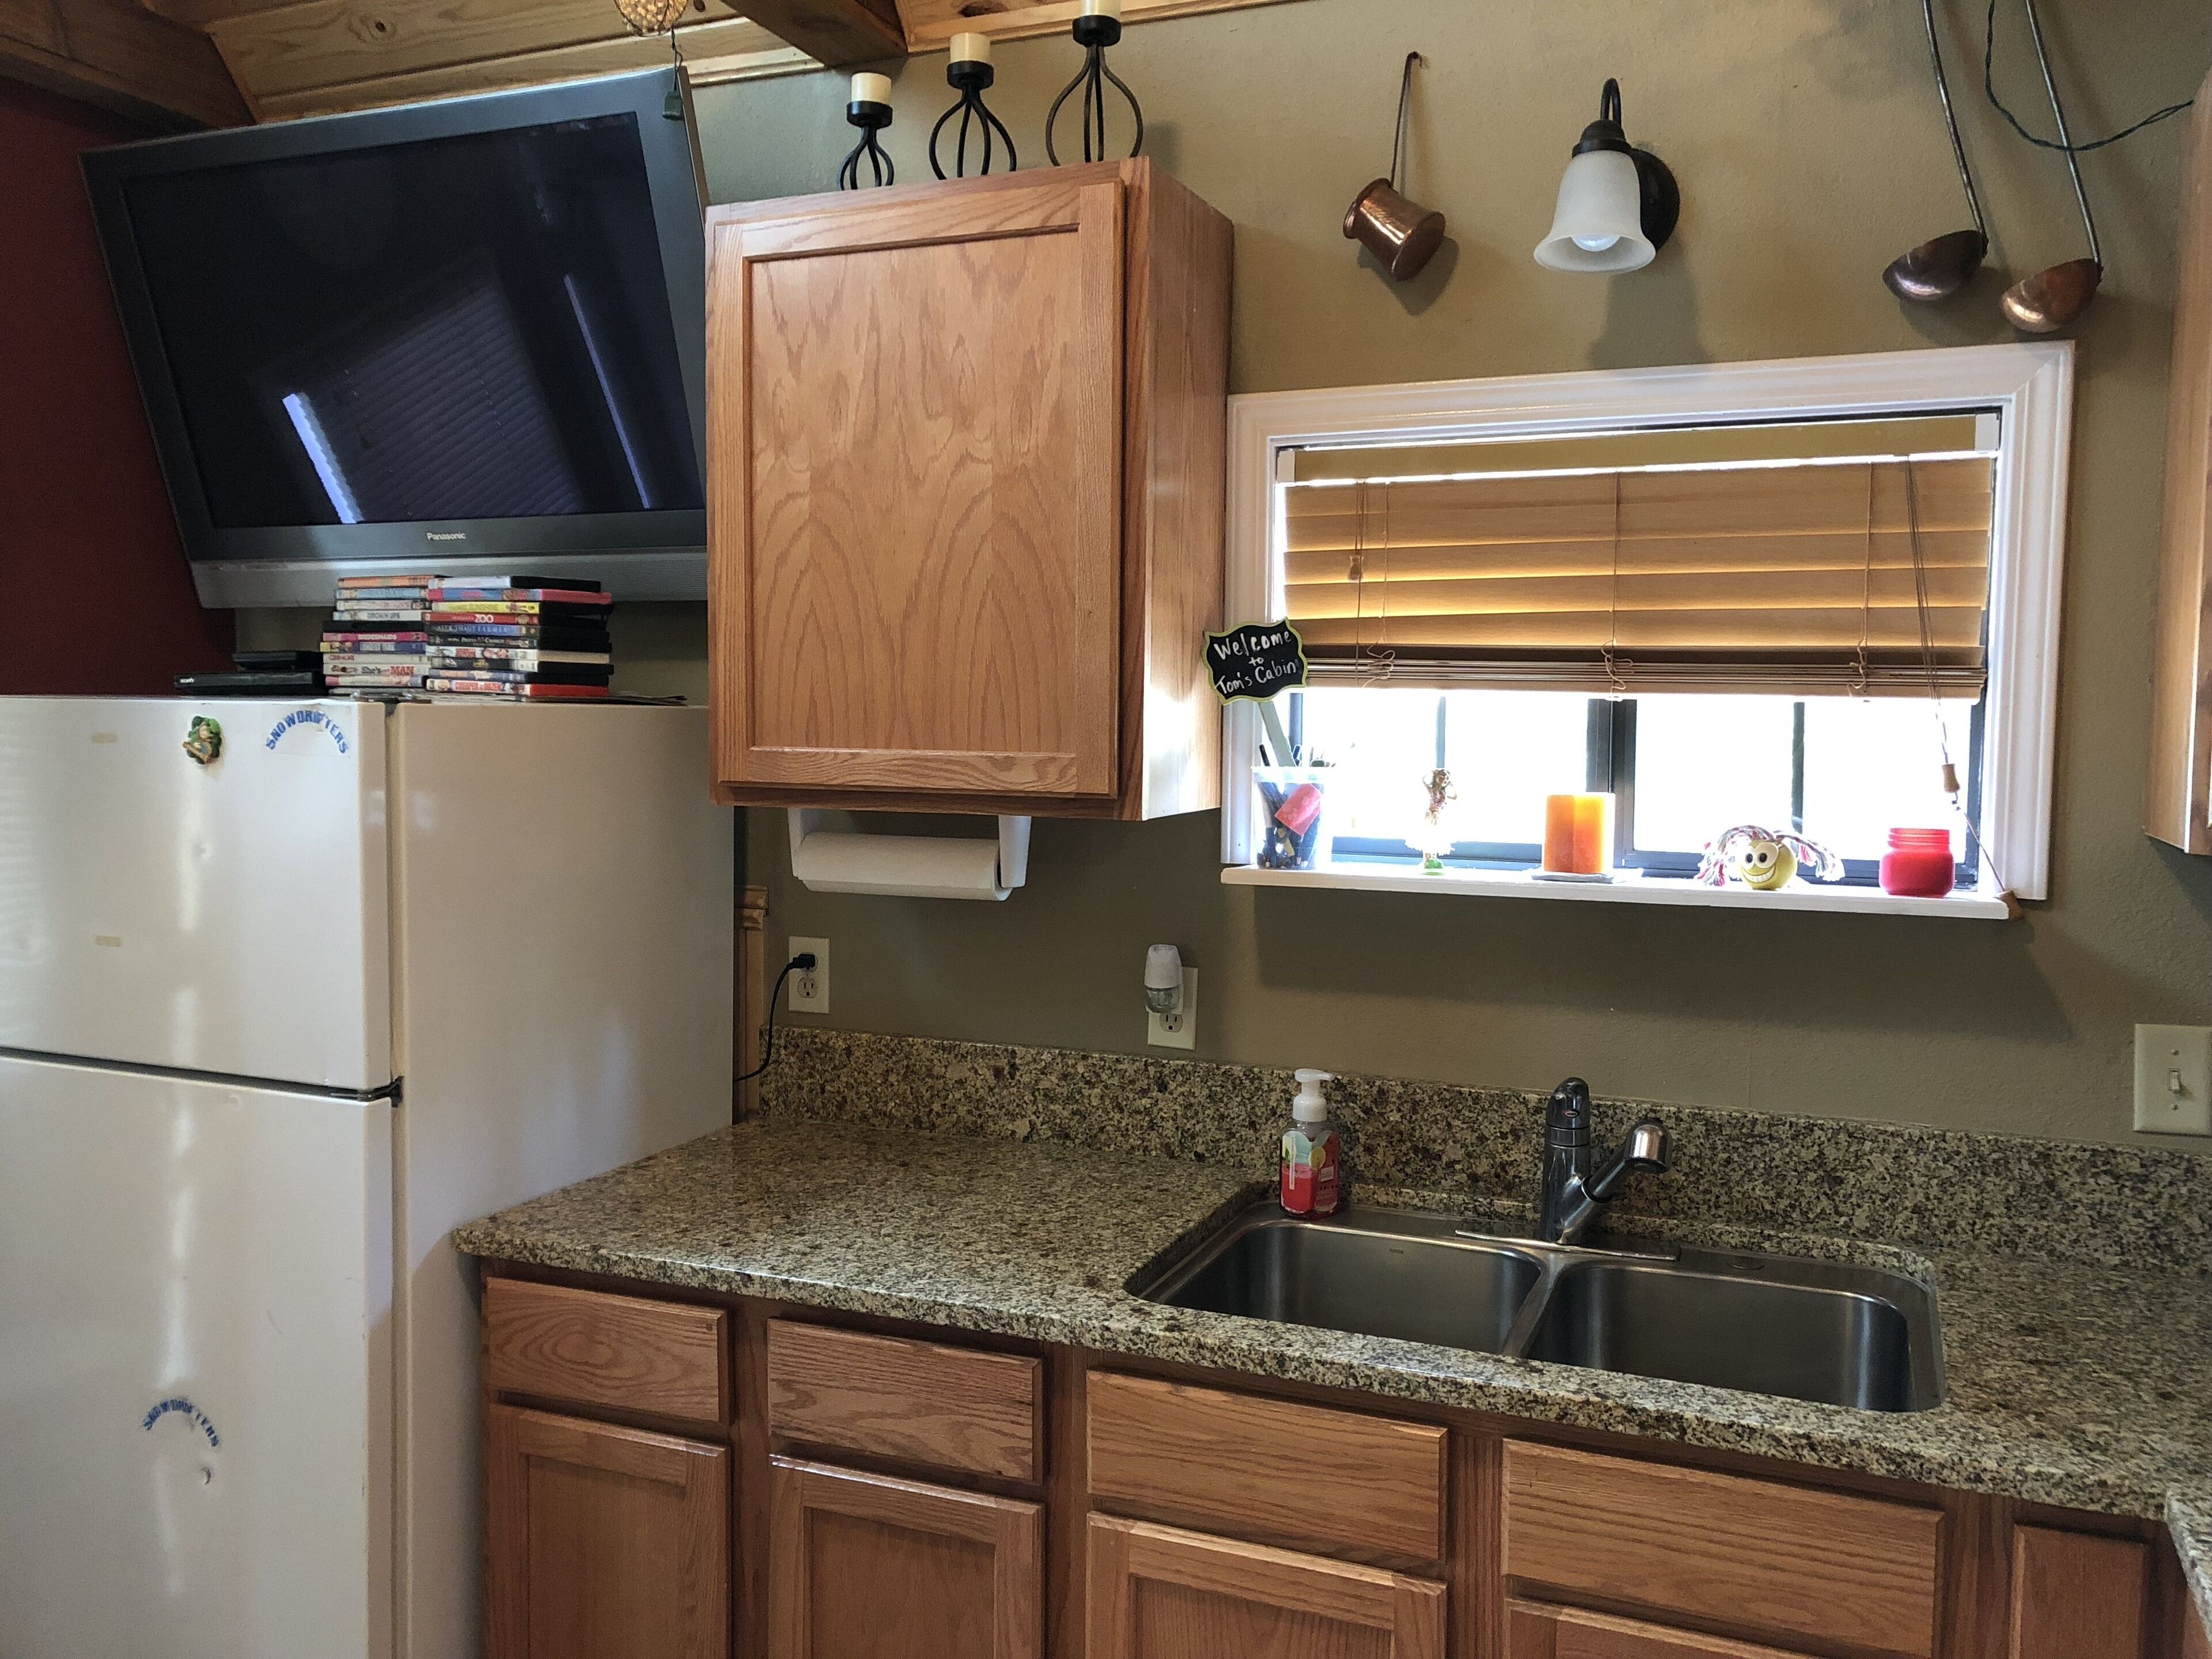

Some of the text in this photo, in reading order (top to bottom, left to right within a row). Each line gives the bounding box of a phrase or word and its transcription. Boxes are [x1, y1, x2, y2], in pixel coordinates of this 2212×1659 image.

[427, 532, 466, 540] Panasonic
[474, 614, 494, 623] ZOO
[1213, 631, 1291, 660] Welcome
[1248, 657, 1264, 666] to
[390, 665, 415, 675] MAN
[1215, 659, 1296, 694] Tom's Cabin
